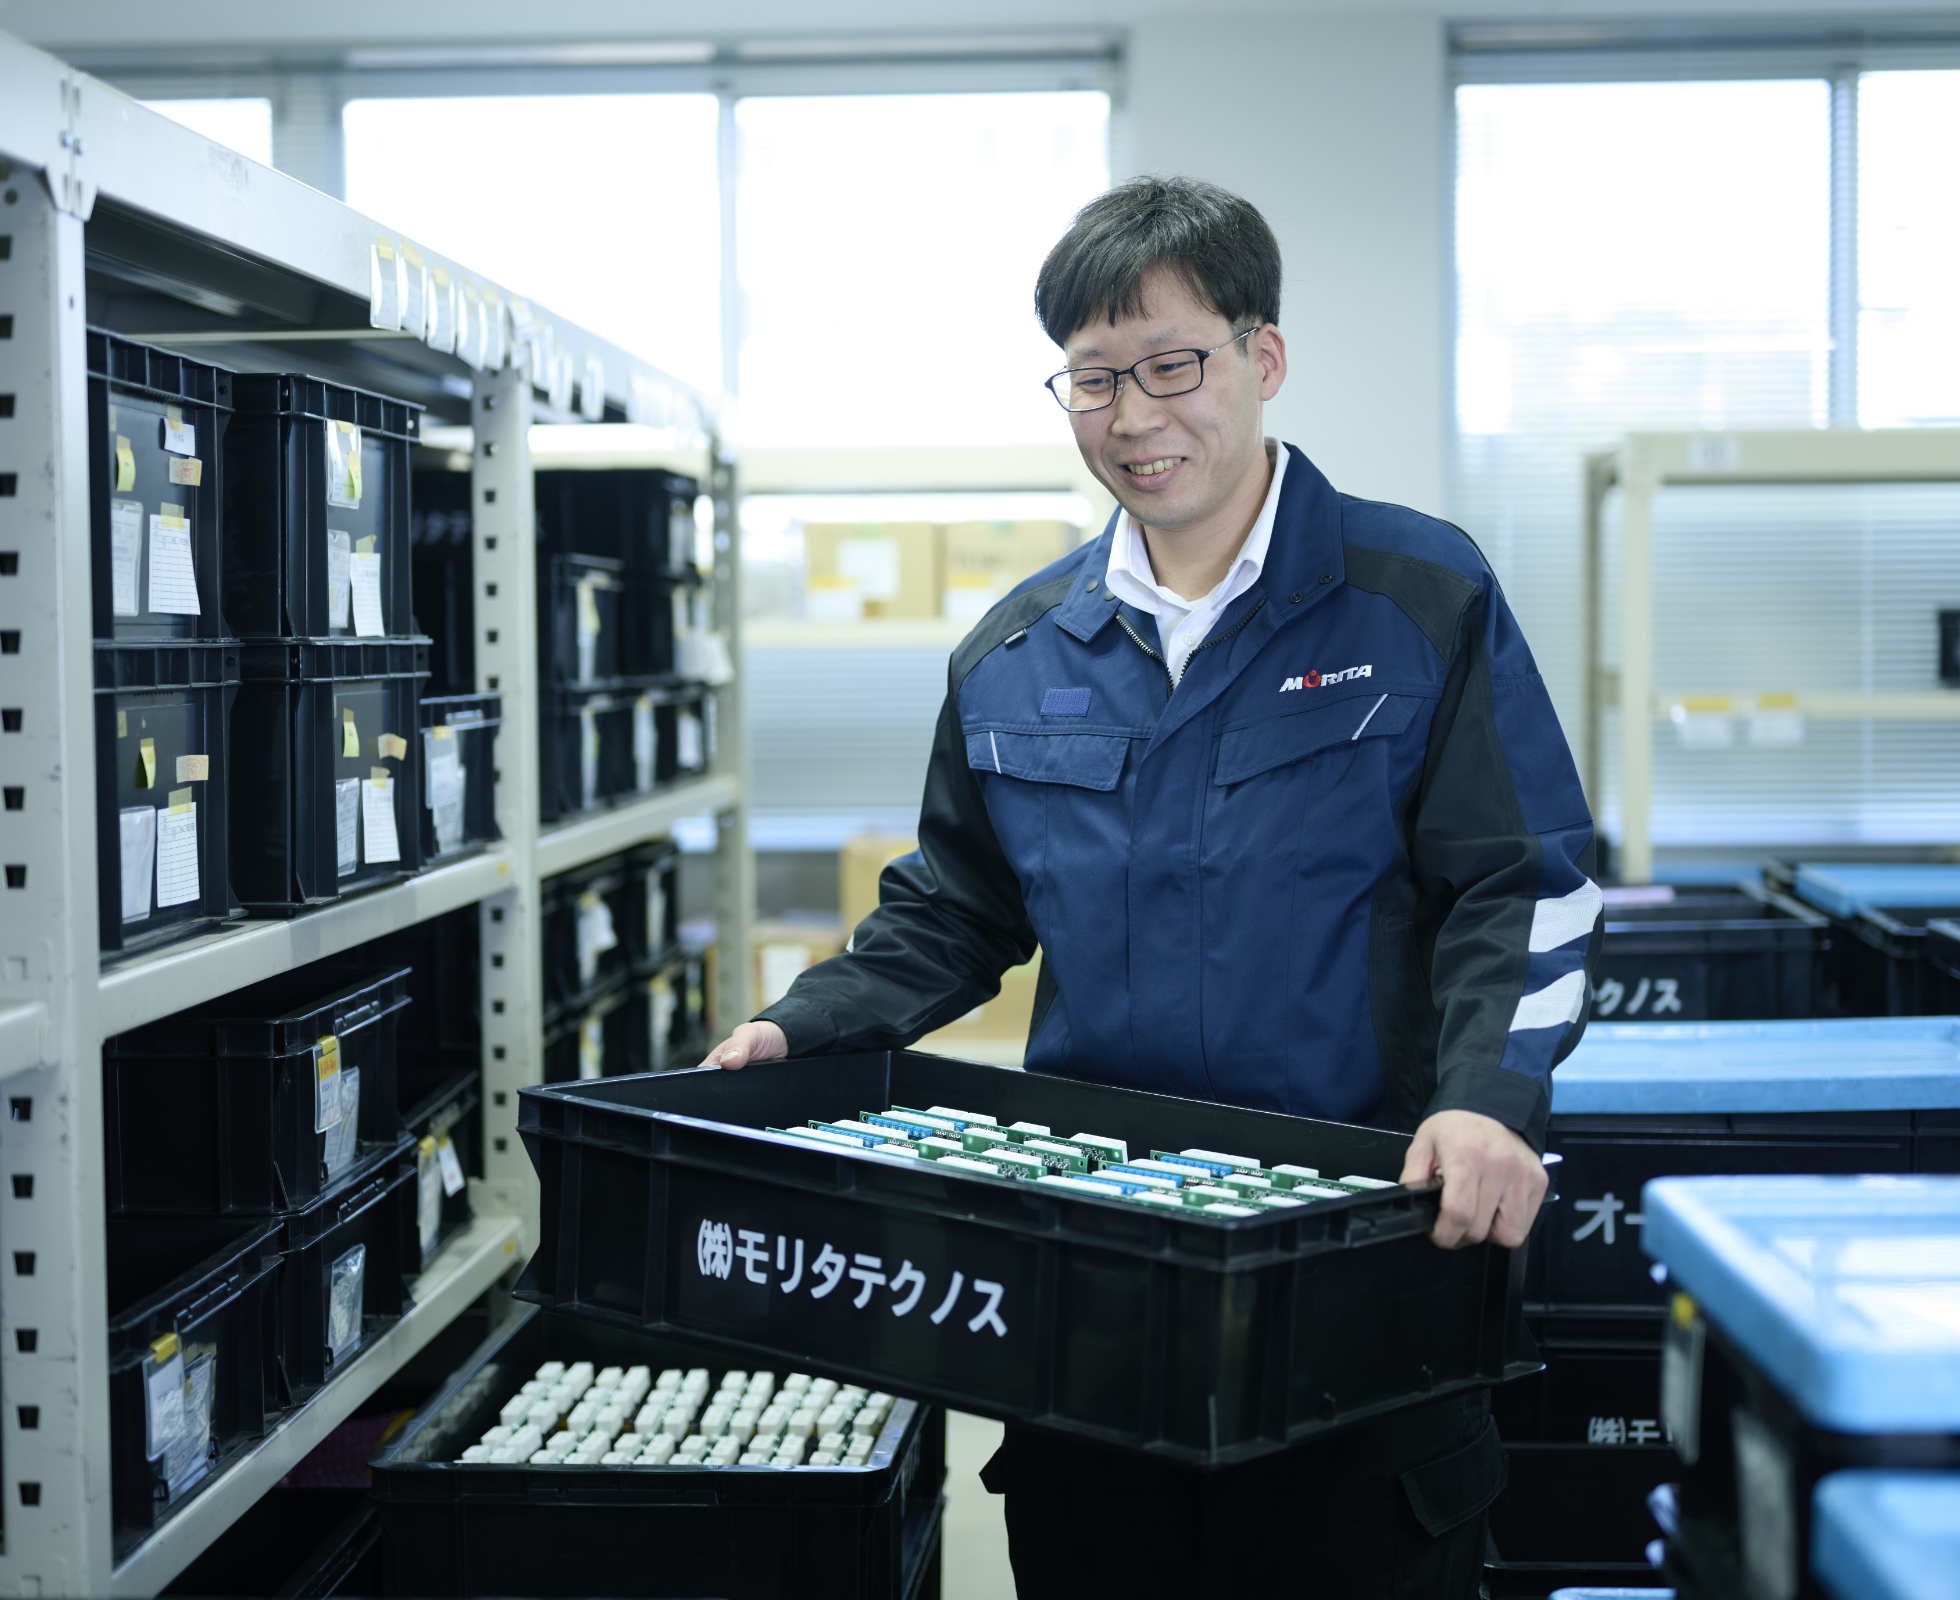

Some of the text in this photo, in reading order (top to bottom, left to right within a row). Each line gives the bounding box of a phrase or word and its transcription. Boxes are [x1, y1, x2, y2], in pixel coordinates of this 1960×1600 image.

[1279, 665, 1372, 692] MORITA
[1591, 977, 1682, 1017] クノス
